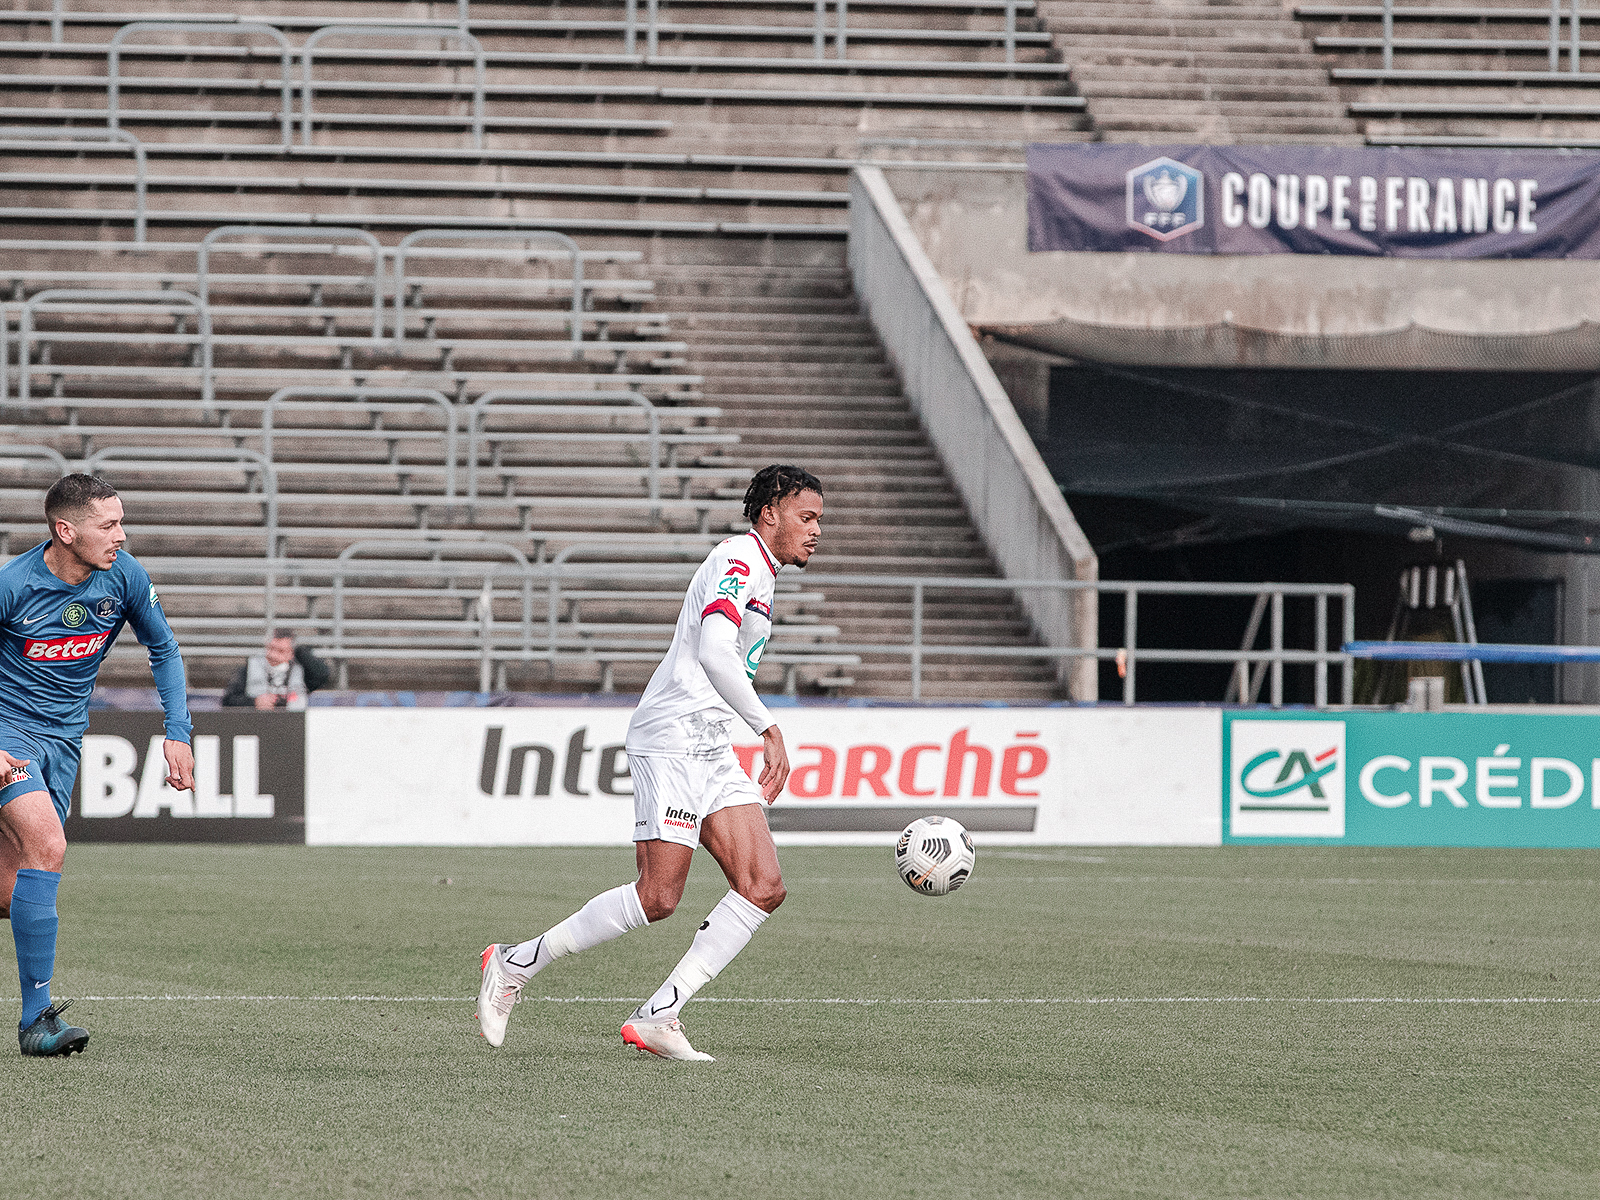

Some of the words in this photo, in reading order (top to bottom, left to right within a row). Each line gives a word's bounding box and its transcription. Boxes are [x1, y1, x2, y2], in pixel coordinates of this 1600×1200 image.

[1222, 172, 1352, 230] COUPE
[1359, 175, 1378, 232] DE
[1385, 177, 1538, 234] FRANCE
